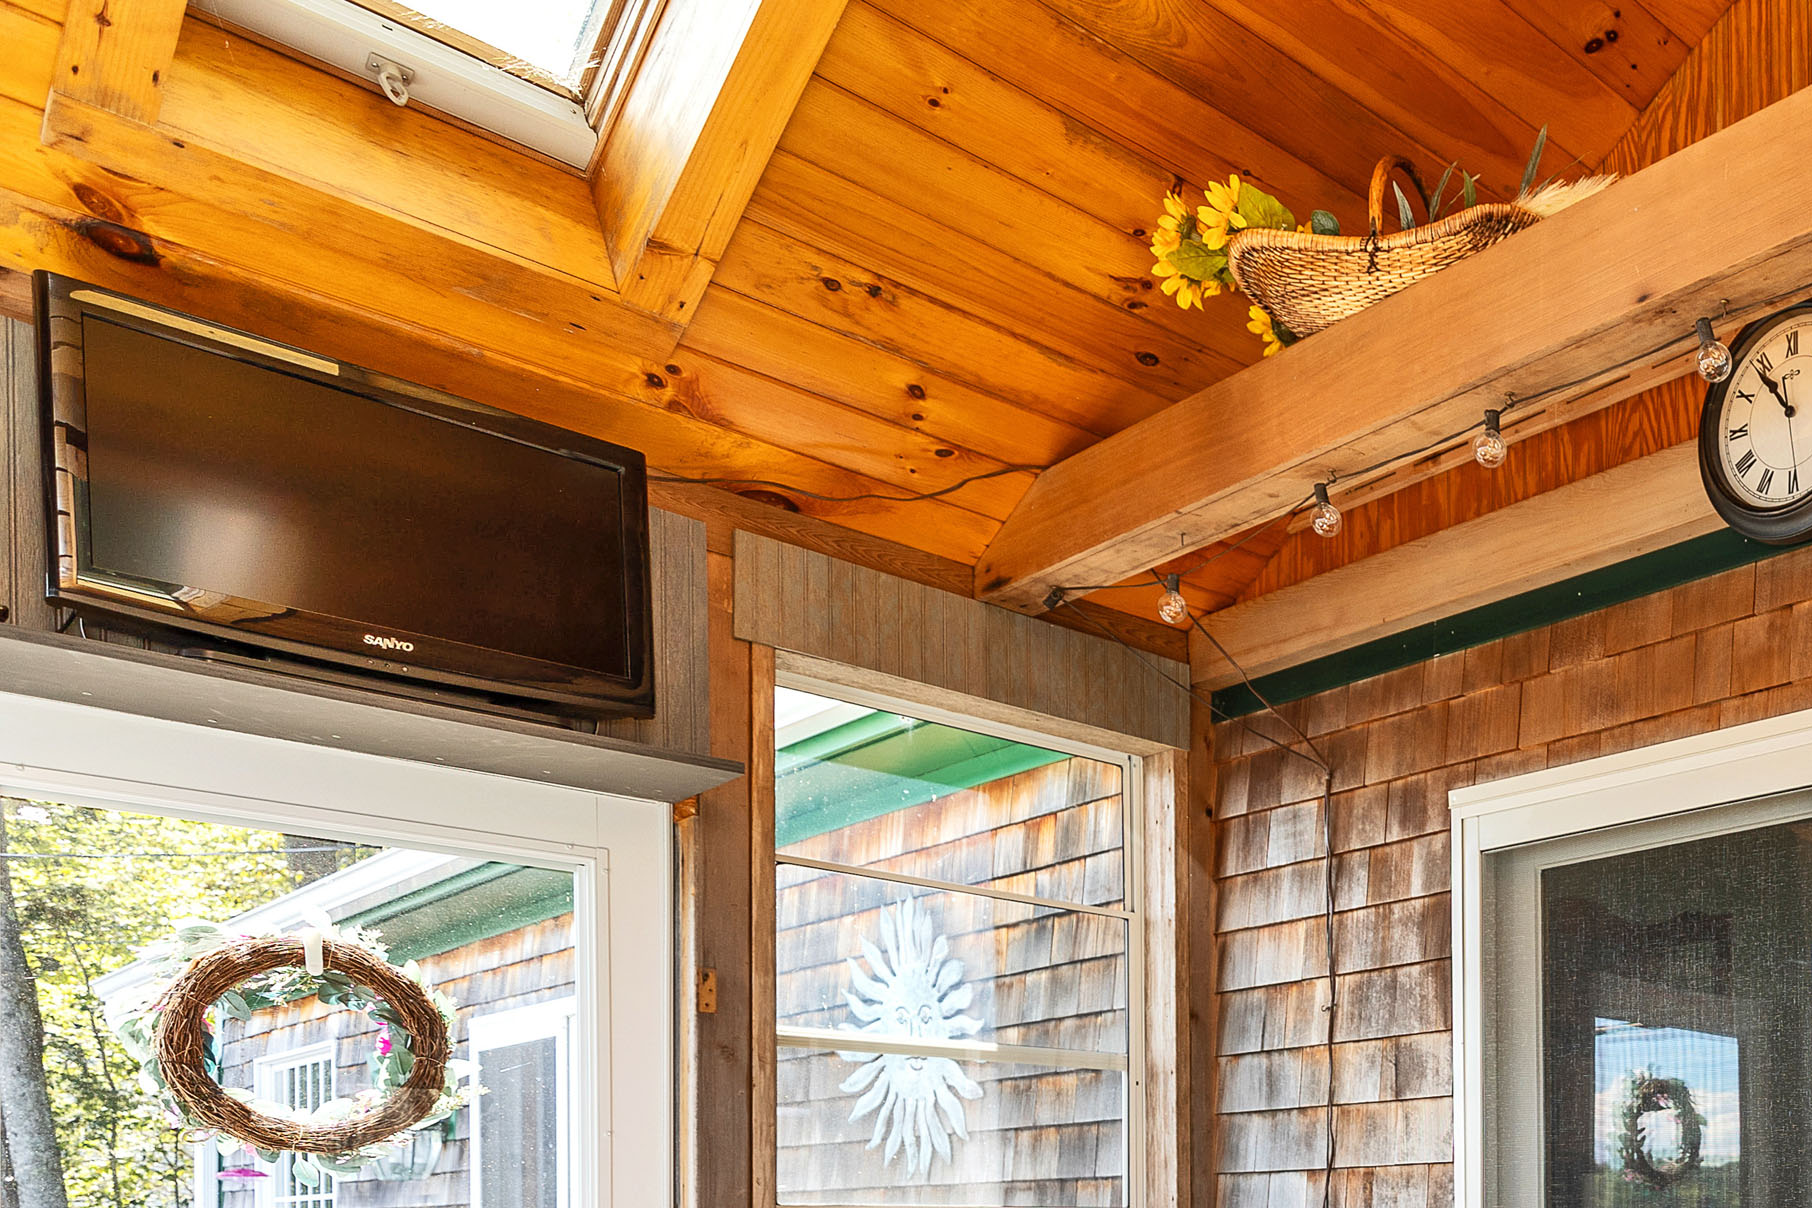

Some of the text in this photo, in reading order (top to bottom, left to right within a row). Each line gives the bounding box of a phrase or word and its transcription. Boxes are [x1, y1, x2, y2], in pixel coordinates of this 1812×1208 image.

[1786, 330, 1799, 358] XII
[1756, 352, 1773, 378] XI
[1736, 389, 1755, 404] X
[1729, 423, 1748, 441] IX
[1735, 449, 1757, 478] VIII
[1756, 468, 1774, 495] VII
[1788, 468, 1799, 494] VI
[363, 634, 414, 652] SANYO
